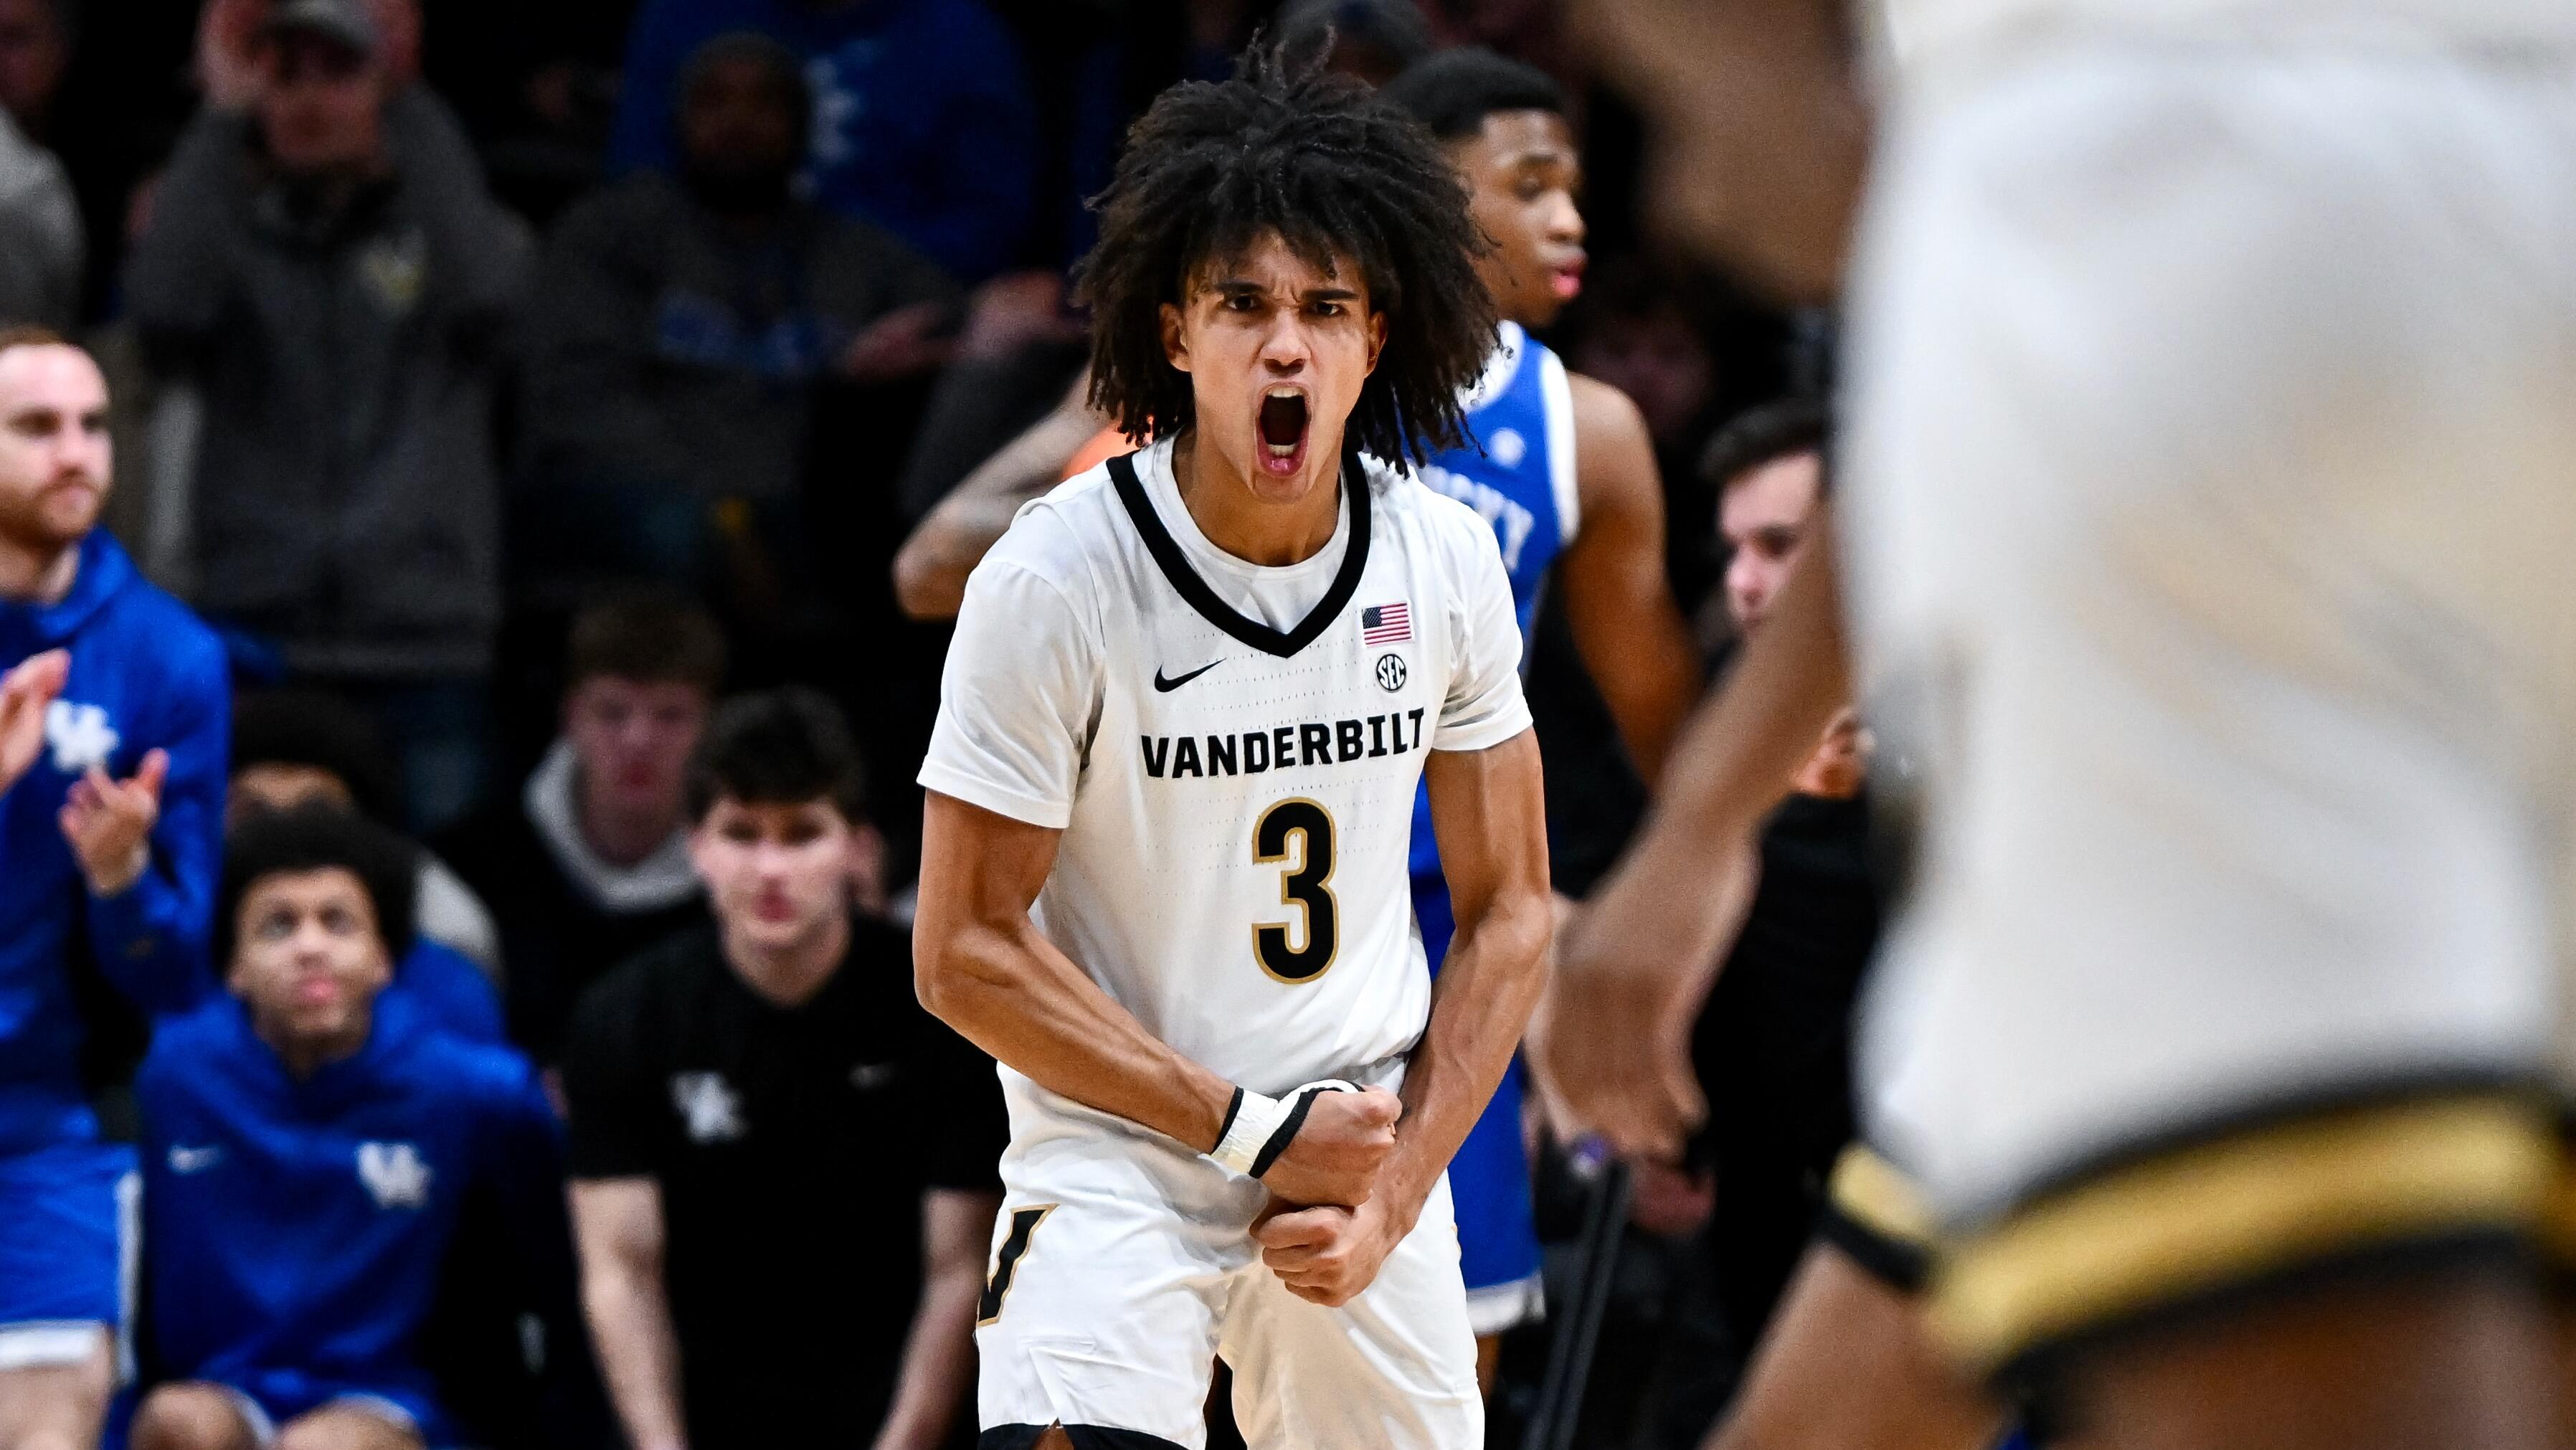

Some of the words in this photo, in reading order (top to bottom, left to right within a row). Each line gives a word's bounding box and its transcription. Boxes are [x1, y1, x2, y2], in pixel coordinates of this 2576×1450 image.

[1377, 655, 1406, 690] SEC
[1141, 707, 1424, 779] VANDERBILT
[1251, 797, 1339, 985] 3
